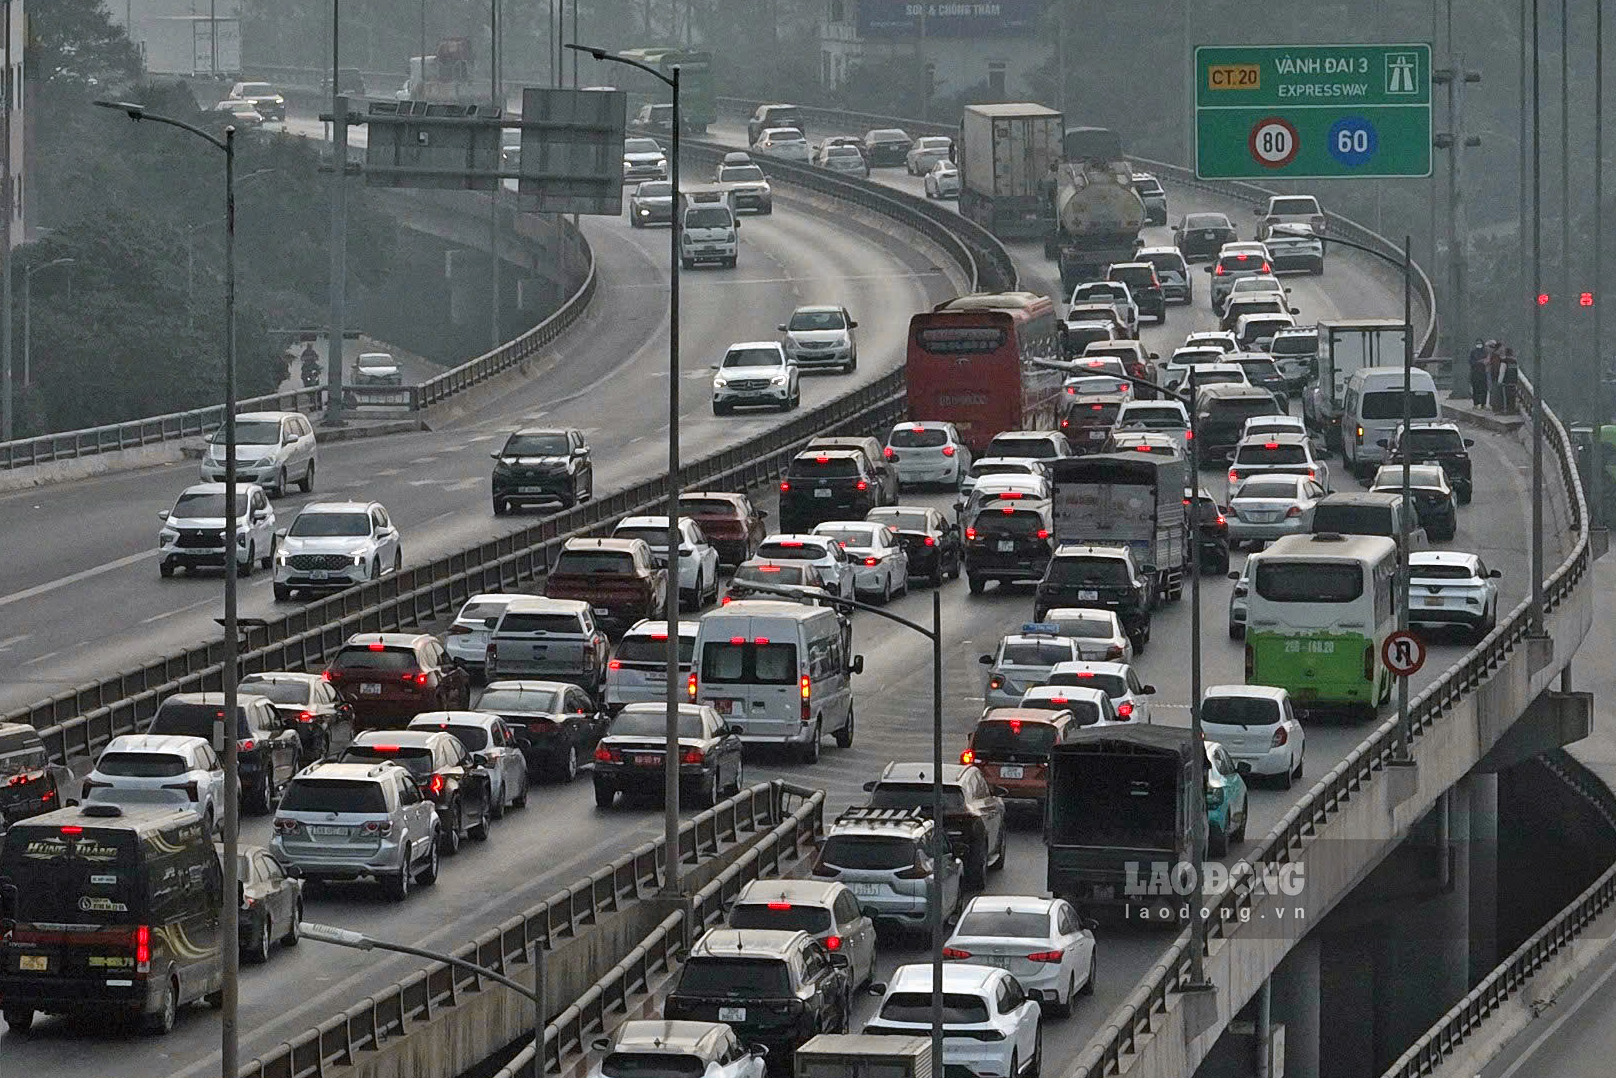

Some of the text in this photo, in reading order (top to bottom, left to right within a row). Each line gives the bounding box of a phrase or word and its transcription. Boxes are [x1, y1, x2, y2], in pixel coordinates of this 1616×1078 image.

[929, 5, 937, 15] &
[1275, 54, 1368, 75] VÀNH ĐAI 3
[1278, 83, 1368, 98] EXPRESSWAY
[1263, 129, 1368, 153] 80 60
